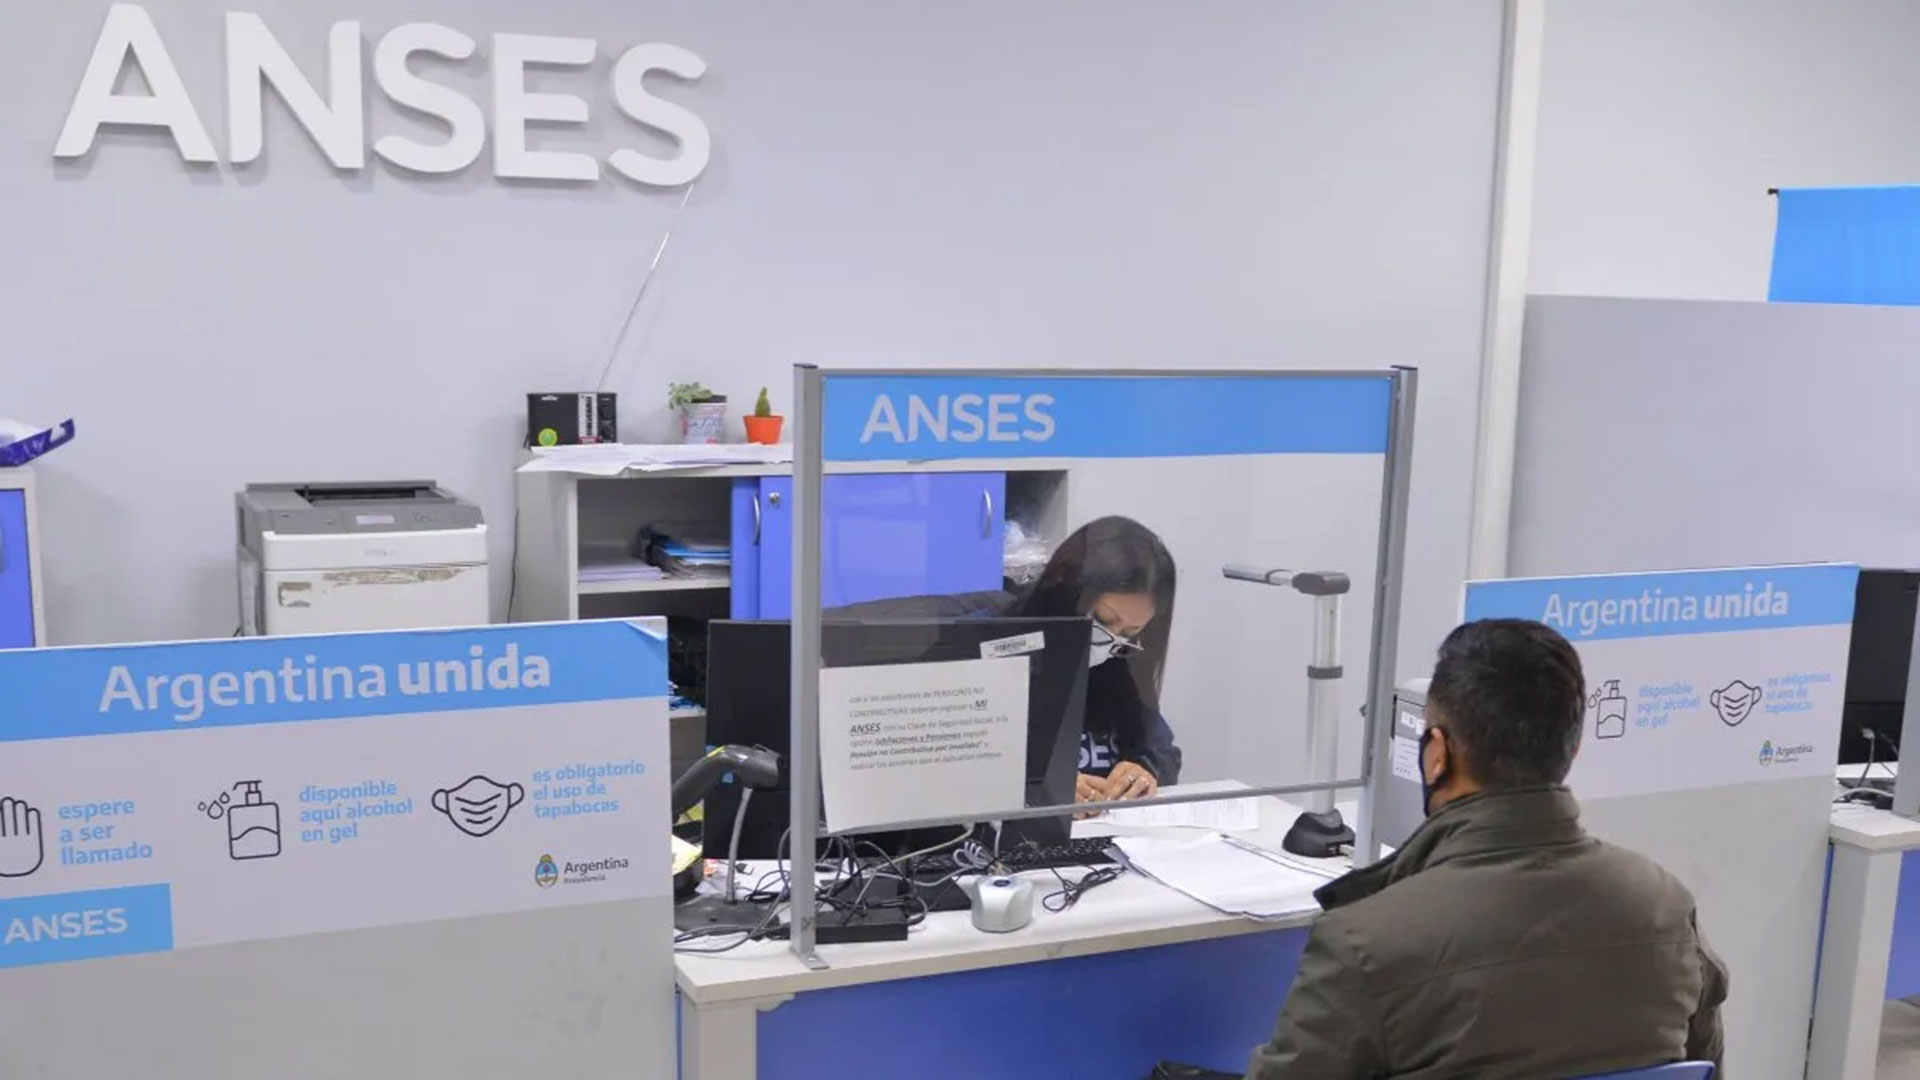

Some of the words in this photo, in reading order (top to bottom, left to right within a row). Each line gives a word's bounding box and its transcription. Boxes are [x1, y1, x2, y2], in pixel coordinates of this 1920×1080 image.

[52, 2, 710, 187] ANSES
[859, 393, 1057, 445] ANSES
[1541, 588, 1697, 636] Argentina
[1704, 582, 1789, 618] unida
[99, 654, 385, 722] Argentina
[398, 643, 551, 696] unida
[1639, 682, 1694, 700] disponible
[849, 722, 881, 736] ANSES
[533, 769, 552, 783] es
[556, 759, 646, 781] obligatorio
[299, 779, 398, 805] disponible
[533, 784, 548, 801] el
[553, 785, 582, 799] uso
[586, 780, 608, 796] de
[58, 799, 136, 823] espere
[300, 803, 341, 825] aquí
[346, 796, 412, 819] alcohol
[533, 799, 620, 820] tapabocas
[60, 828, 74, 843] a
[79, 824, 116, 843] ser
[301, 828, 324, 843] en
[329, 821, 358, 844] gel
[61, 840, 154, 866] llamado
[564, 856, 630, 876] Argentina
[4, 907, 129, 946] ANSES
